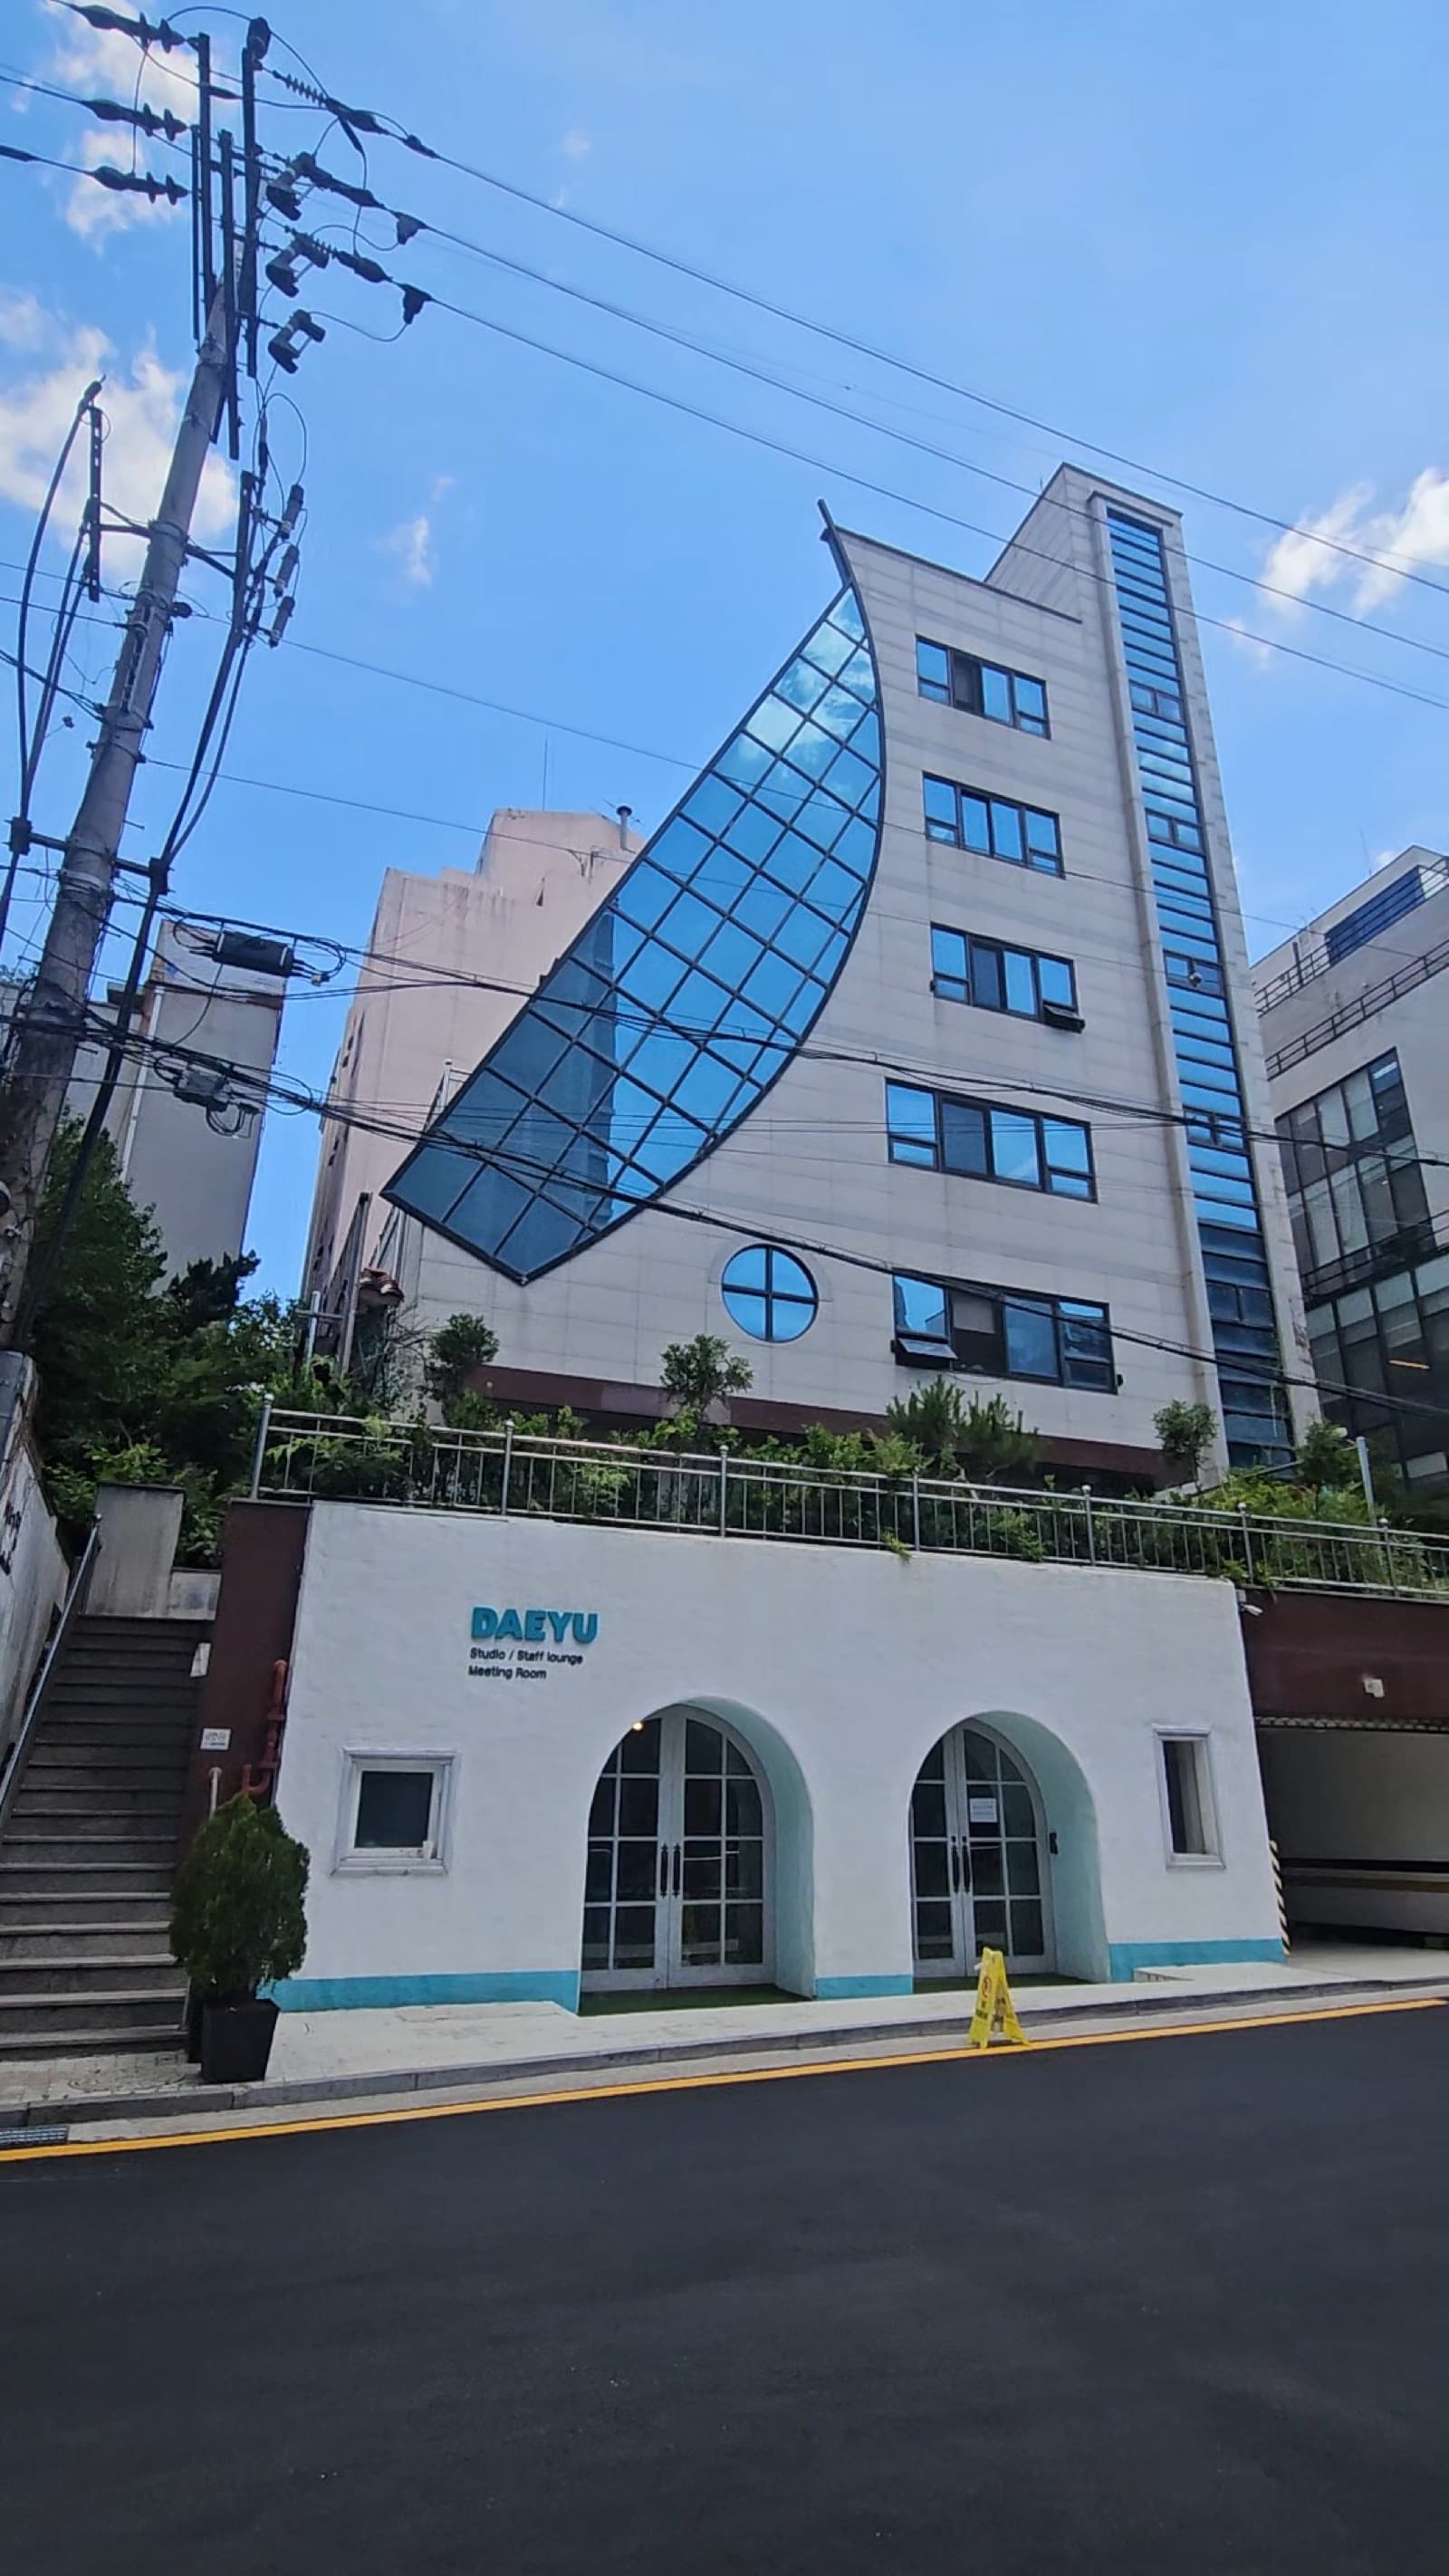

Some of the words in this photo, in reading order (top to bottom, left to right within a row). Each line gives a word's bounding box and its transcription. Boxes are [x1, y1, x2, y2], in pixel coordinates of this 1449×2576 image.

[471, 1607, 598, 1644] DAEYU
[470, 1647, 506, 1660] Studio
[517, 1649, 544, 1661] Staff
[547, 1652, 584, 1666] lounge
[468, 1665, 513, 1680] Meeting
[515, 1668, 547, 1679] Room
